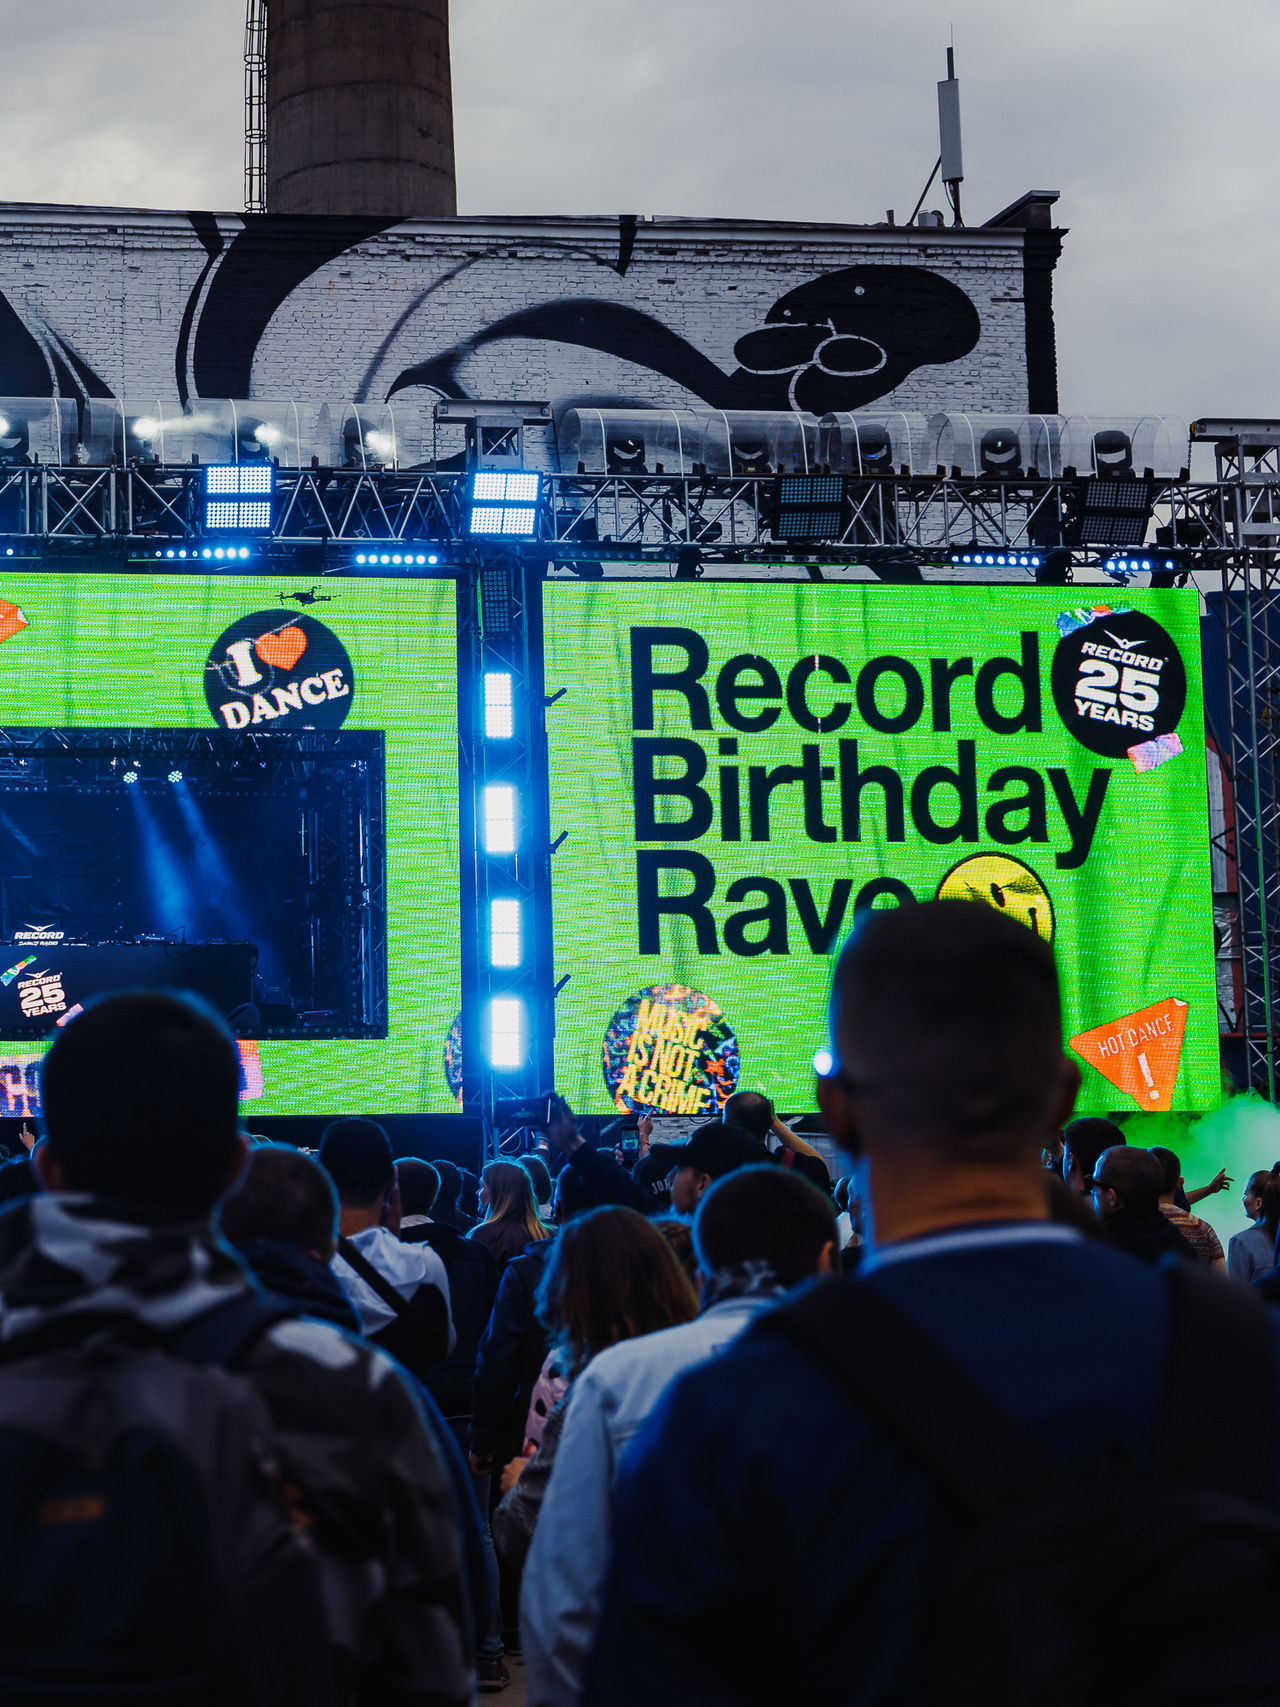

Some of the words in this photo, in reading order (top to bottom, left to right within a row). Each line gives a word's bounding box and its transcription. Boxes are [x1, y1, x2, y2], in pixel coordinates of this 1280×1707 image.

[226, 640, 263, 687] I
[629, 626, 1043, 733] Record
[1081, 641, 1163, 671] RECORD
[220, 668, 350, 730] DANCE
[1075, 658, 1160, 713] 25
[1074, 698, 1155, 732] YEARS
[631, 737, 1112, 869] Birthday
[14, 931, 65, 940] RECORD
[17, 974, 61, 989] RECORD
[19, 982, 66, 1010] 25
[22, 1002, 67, 1018] YEARS
[635, 999, 707, 1050] MUSIC
[627, 1031, 652, 1066] IS
[650, 1039, 700, 1082] NOT
[1098, 1033, 1126, 1059] HOT
[1127, 1014, 1175, 1047] DANCE
[616, 1064, 638, 1098] A
[639, 1069, 711, 1114] CRIME
